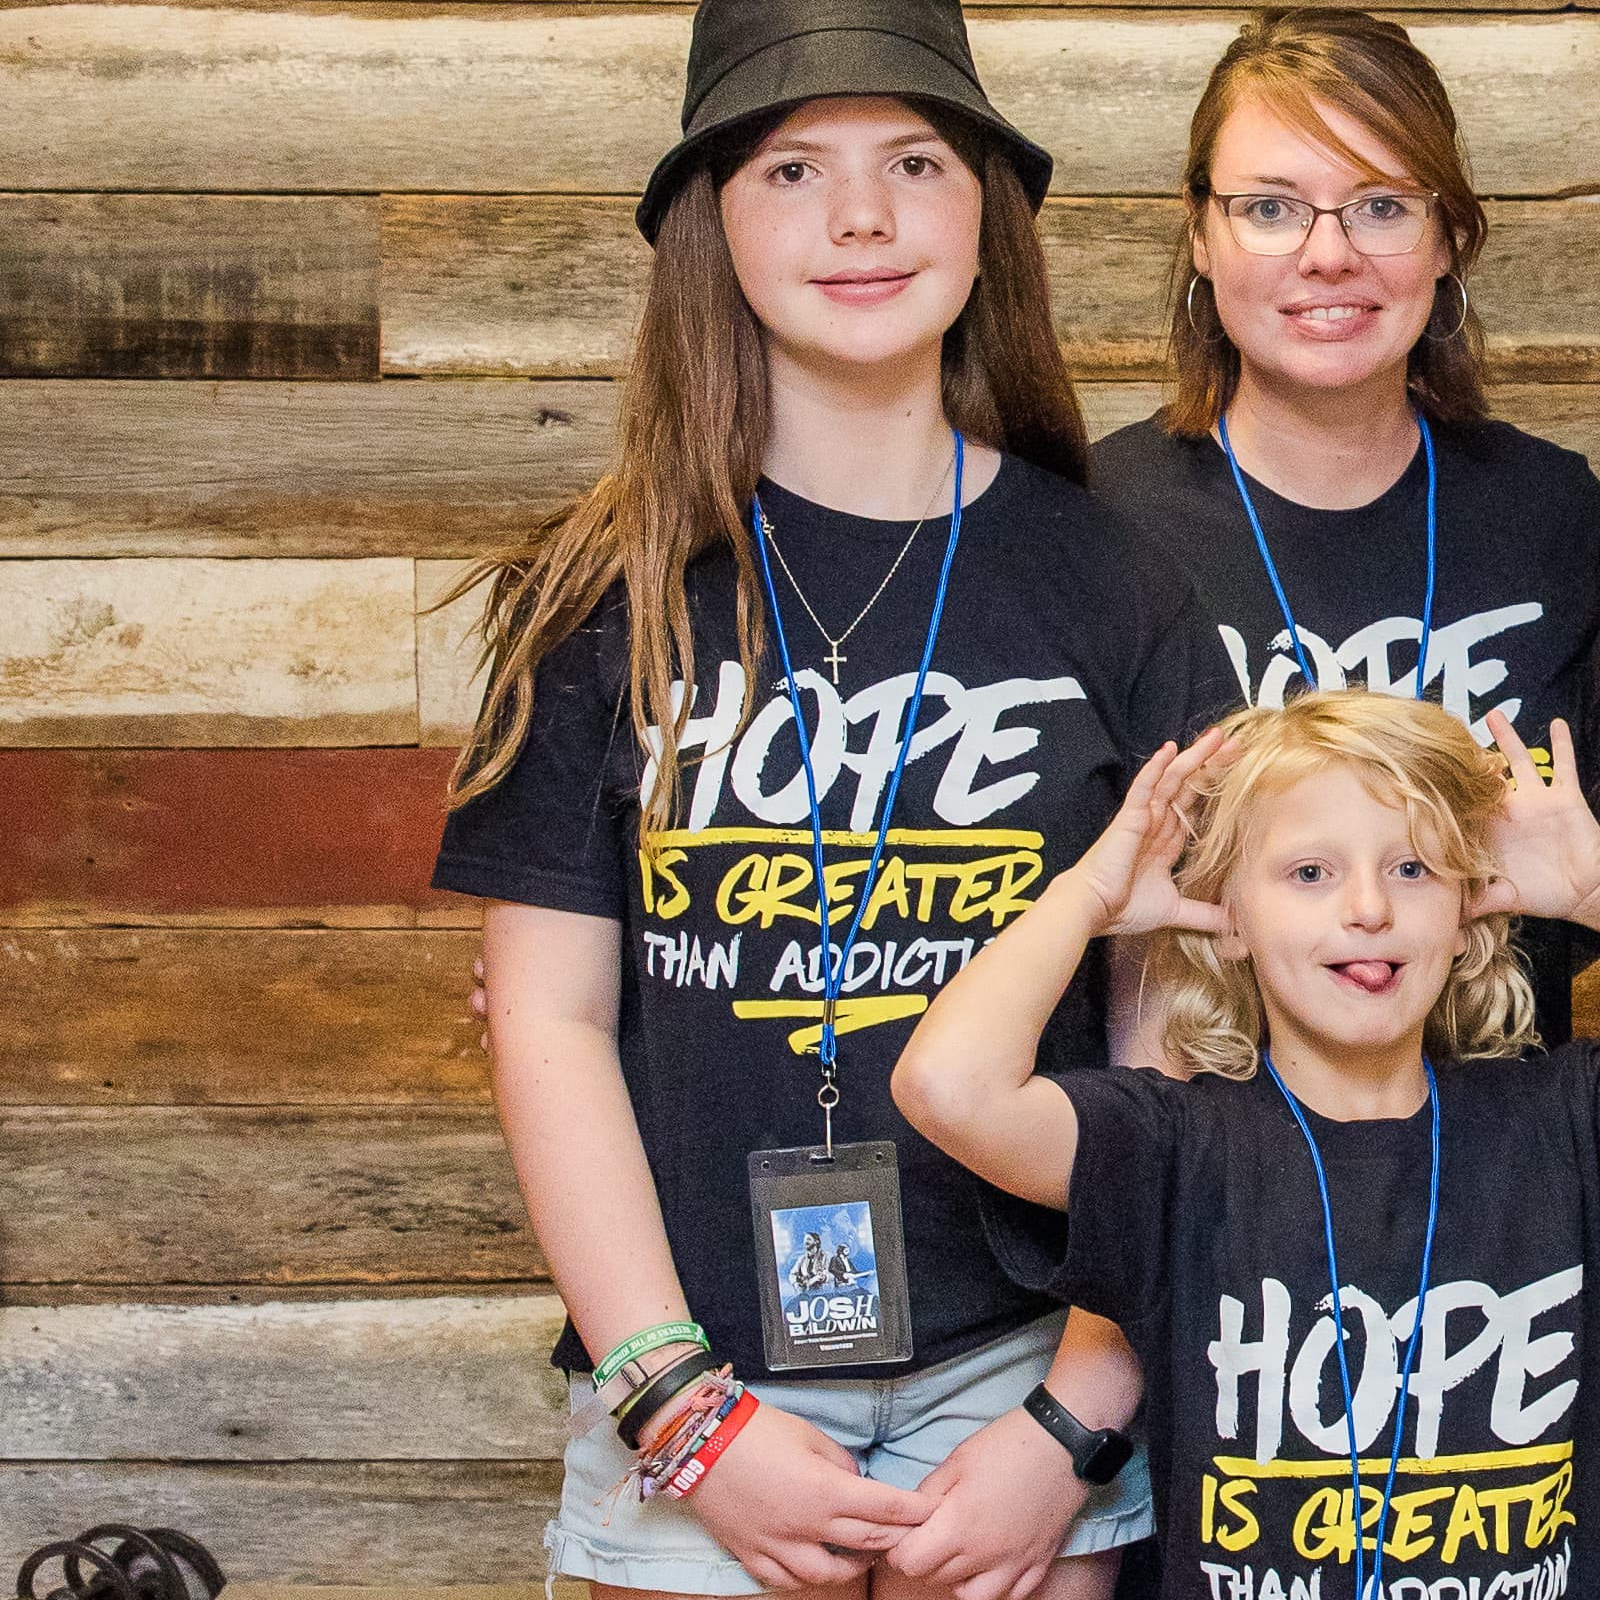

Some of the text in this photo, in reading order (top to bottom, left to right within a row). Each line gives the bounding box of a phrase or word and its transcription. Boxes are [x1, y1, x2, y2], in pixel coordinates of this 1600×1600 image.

[1217, 601, 1544, 749] OPE
[640, 660, 1088, 834] HOPE
[639, 848, 1044, 931] IS GREATER
[643, 930, 997, 994] THAN ADDICTI
[785, 1294, 875, 1324] JOSH
[788, 1315, 878, 1337] BALDWIN
[1207, 1263, 1584, 1466] HOPE
[1201, 1461, 1577, 1566] IS GREATER
